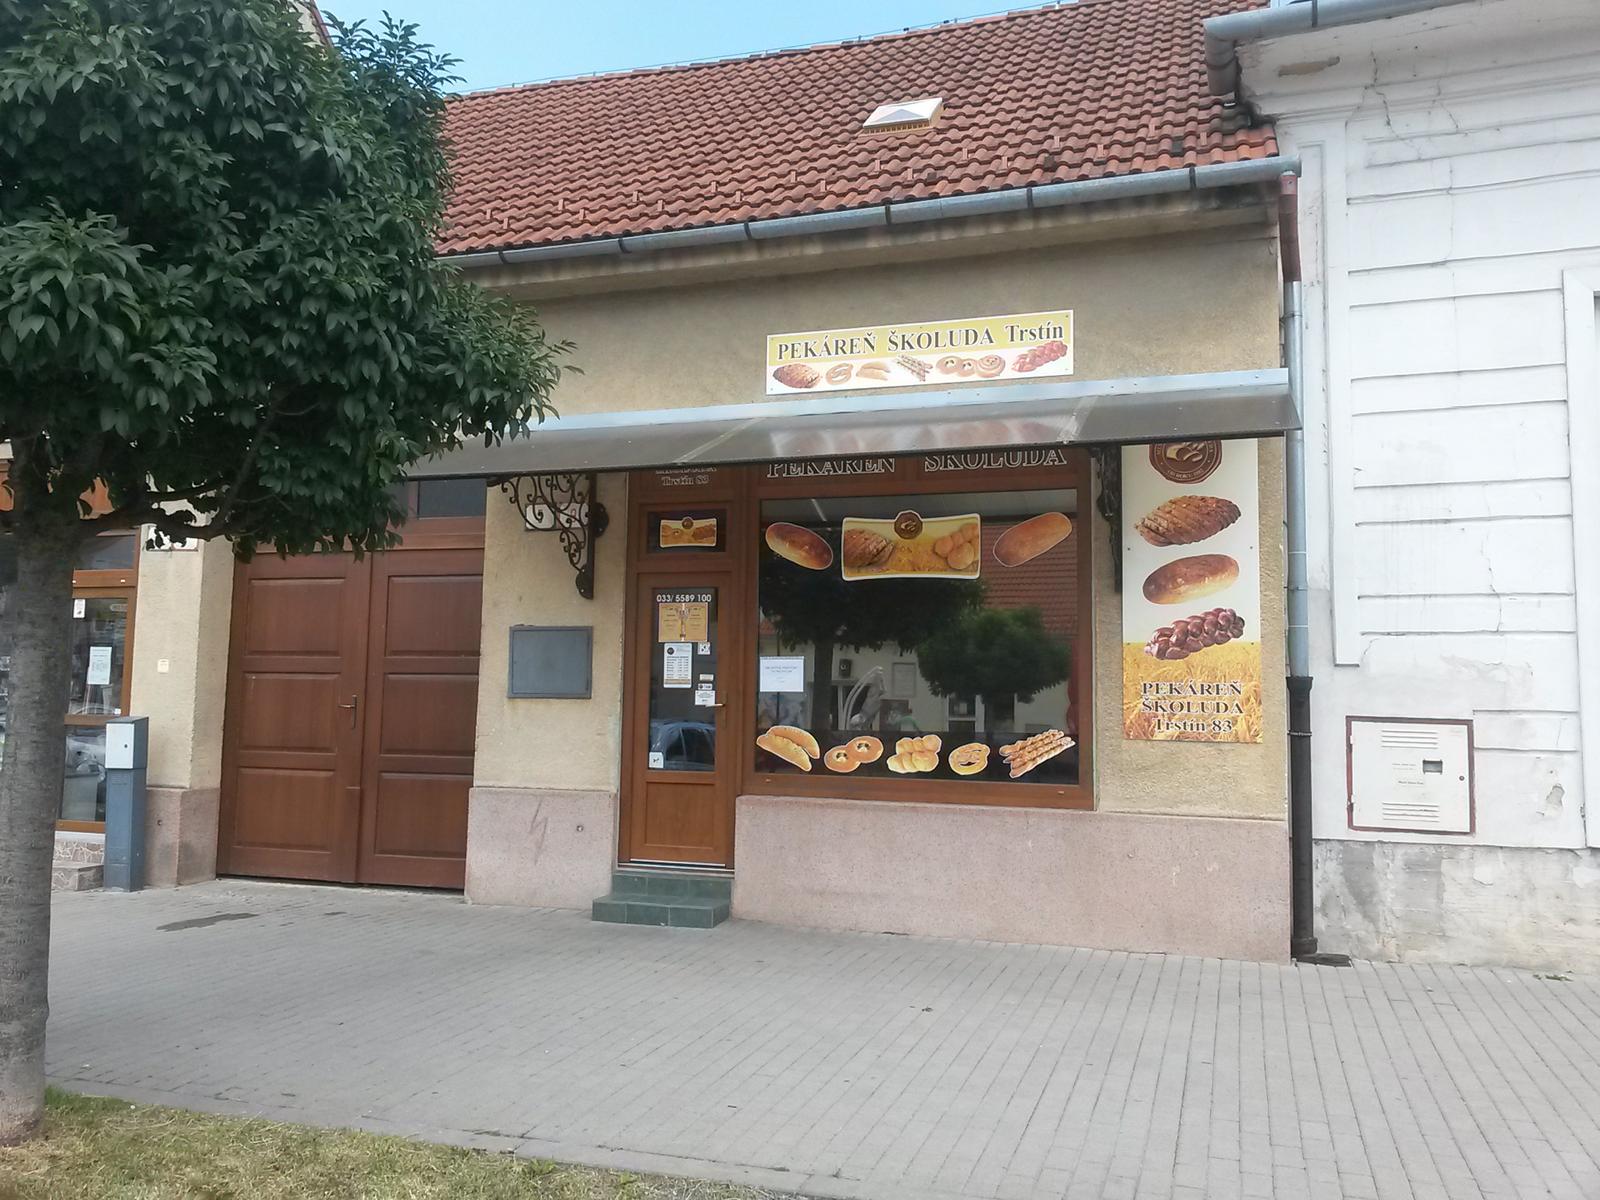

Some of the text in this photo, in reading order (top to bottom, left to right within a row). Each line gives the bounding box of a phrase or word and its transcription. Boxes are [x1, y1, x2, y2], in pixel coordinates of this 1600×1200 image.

[778, 321, 1064, 360] PEKÁREŇ ŠKOLUDA Trstín
[656, 594, 712, 602] 033/ 5589 100
[1142, 679, 1243, 696] PEKÁREŇ
[1142, 697, 1244, 714] ŠKOLUDA
[1152, 718, 1233, 732] Trstín 83
